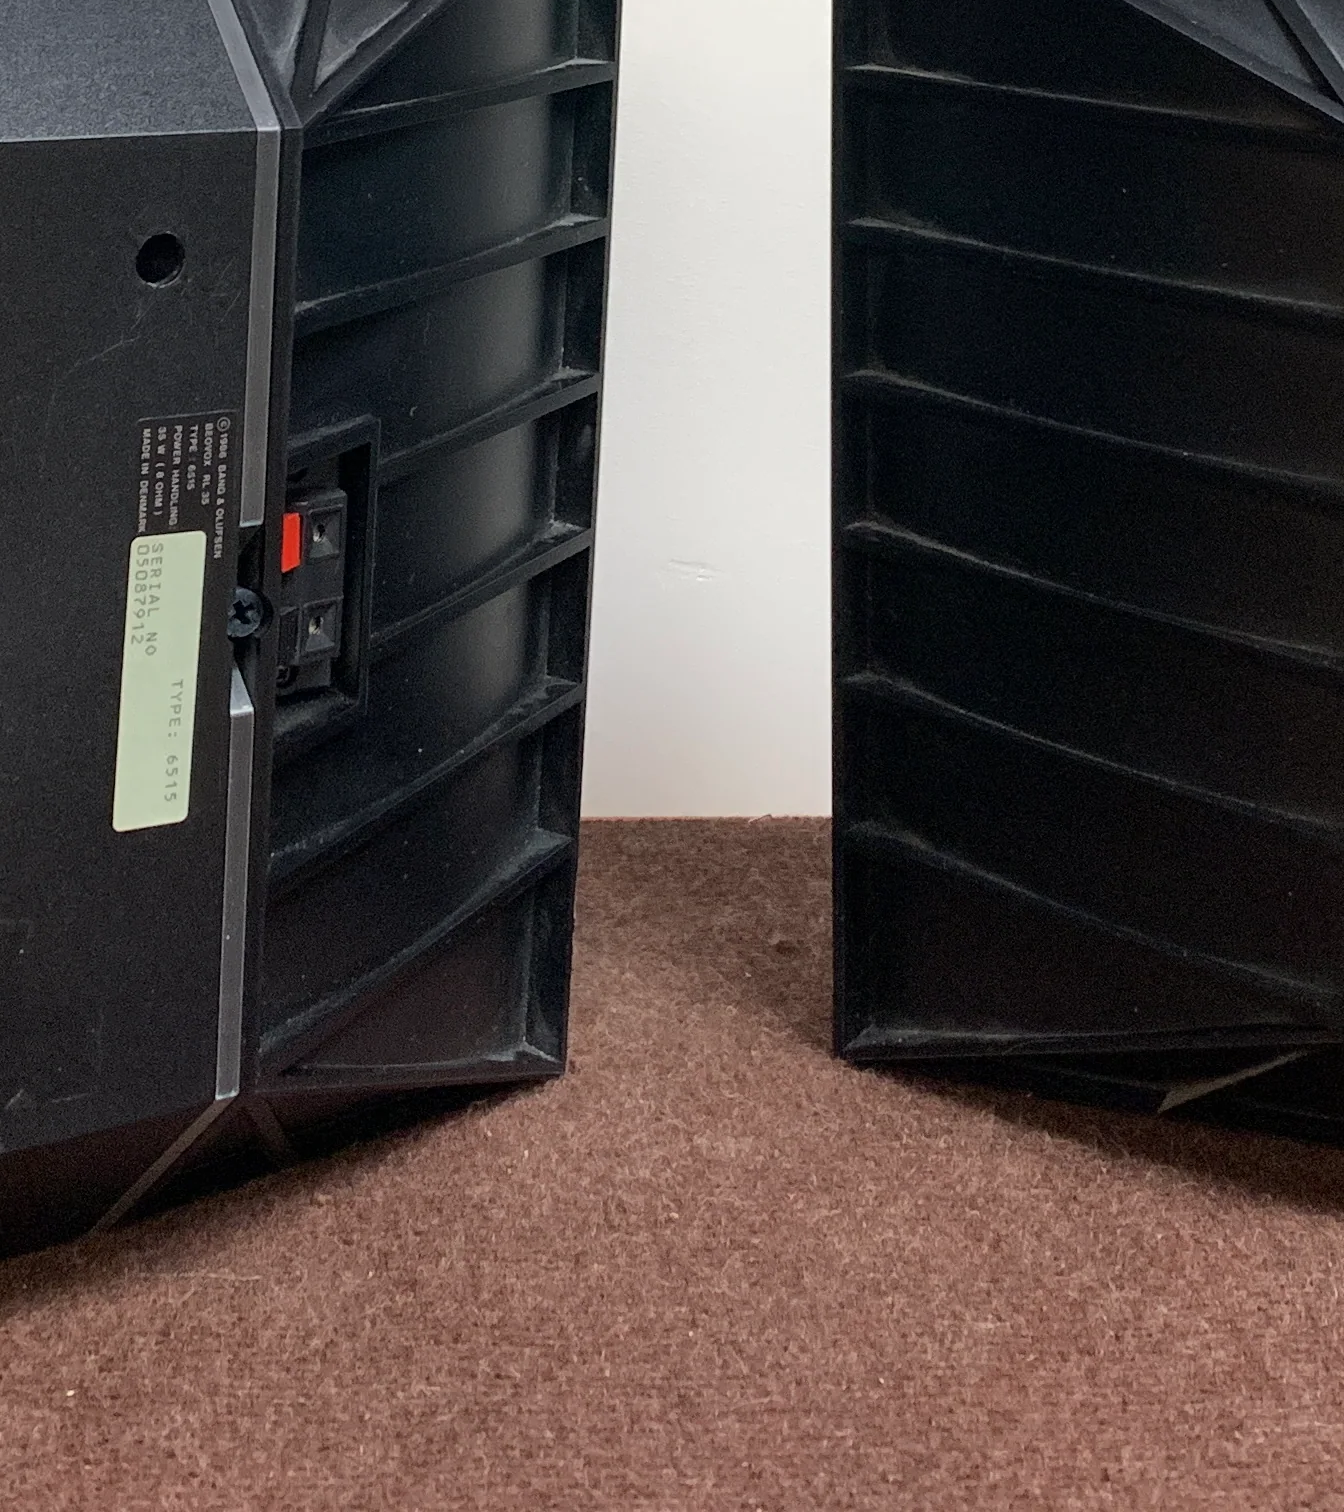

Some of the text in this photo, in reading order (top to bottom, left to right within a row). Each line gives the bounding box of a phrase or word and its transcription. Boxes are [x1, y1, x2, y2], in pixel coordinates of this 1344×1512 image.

[157, 426, 167, 441] 35
[157, 444, 166, 455] W
[172, 425, 183, 465] POWER
[138, 428, 151, 533] MADE IN DENMARK
[187, 464, 197, 491] 6515
[201, 422, 214, 505] BEOVOX RL 35
[216, 464, 227, 495] BANG
[216, 498, 225, 506] &
[213, 508, 225, 559] OLUFSEN
[131, 544, 150, 645] 05087912
[145, 542, 164, 656] SERIAL NO
[164, 678, 183, 802] TYPE: 6515
